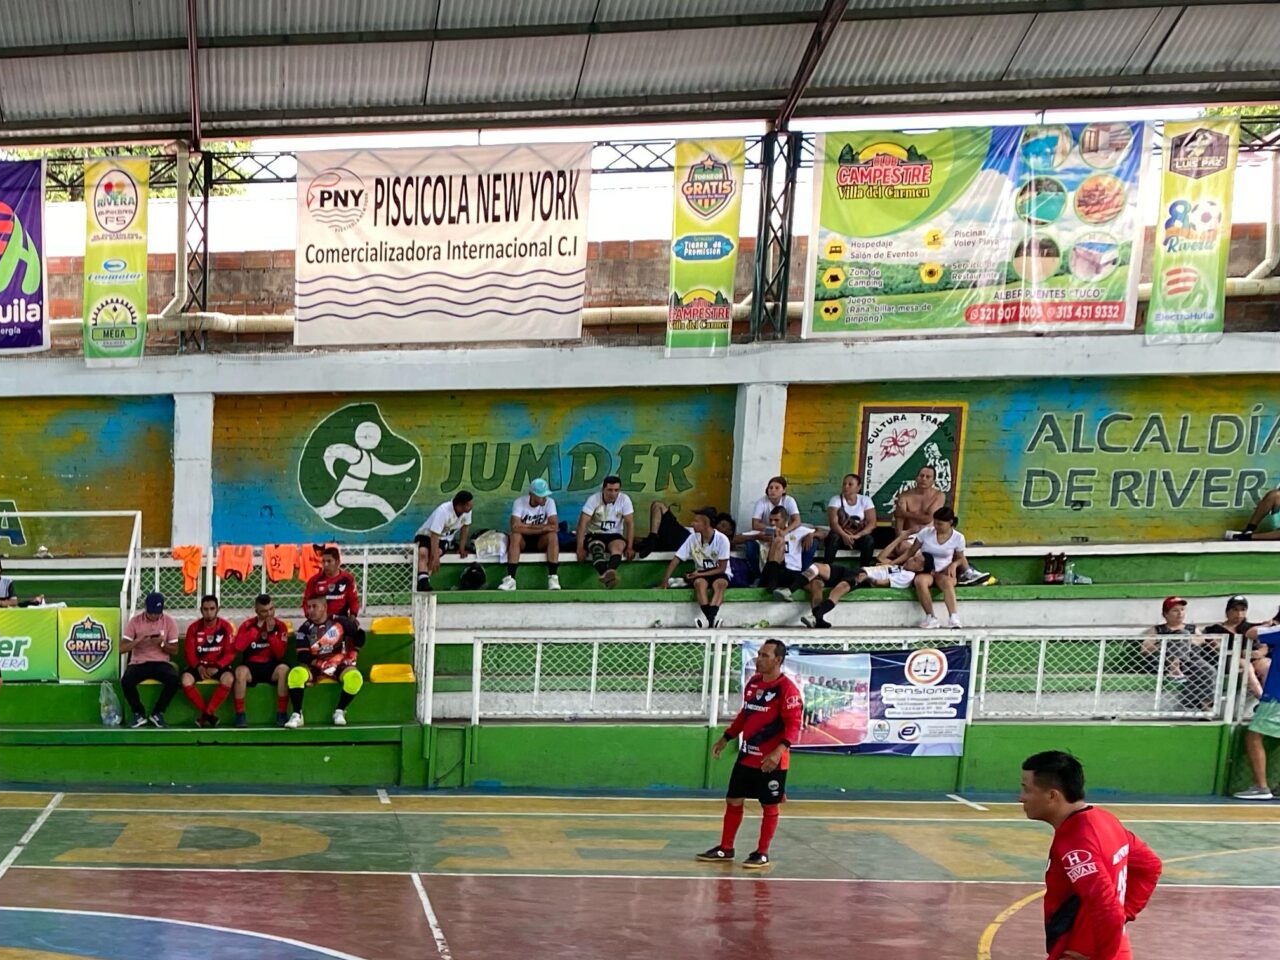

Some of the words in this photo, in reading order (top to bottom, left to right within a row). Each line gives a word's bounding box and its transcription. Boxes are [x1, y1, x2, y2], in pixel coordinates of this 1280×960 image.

[1175, 160, 1198, 168] LUIS
[837, 164, 932, 185] CAMPESTRE
[682, 180, 732, 195] GRATIS
[838, 186, 863, 199] Villa
[866, 186, 882, 199] del
[884, 186, 929, 198] Carmen
[319, 189, 364, 208] PNY
[374, 175, 470, 227] PISCICOLA
[476, 172, 524, 223] NEW
[529, 168, 580, 221] YORK
[305, 240, 441, 264] Comercializadora
[447, 235, 552, 260] Internacional
[850, 240, 894, 249] Hospedaje
[850, 251, 872, 259] Salón
[886, 250, 919, 258] Eventos
[870, 268, 880, 276] de
[848, 280, 883, 288] Camping
[848, 297, 876, 305] Juegos
[921, 303, 932, 312] de
[980, 307, 996, 321] 321
[1075, 304, 1093, 318] 431
[1095, 304, 1120, 318] 9332
[867, 413, 907, 444] CULTURA
[440, 440, 696, 494] JUMDER
[1021, 468, 1098, 510] DE
[1108, 468, 1269, 510] RIVER
[67, 639, 109, 651] GRATIS
[883, 686, 961, 695] Pensiones
